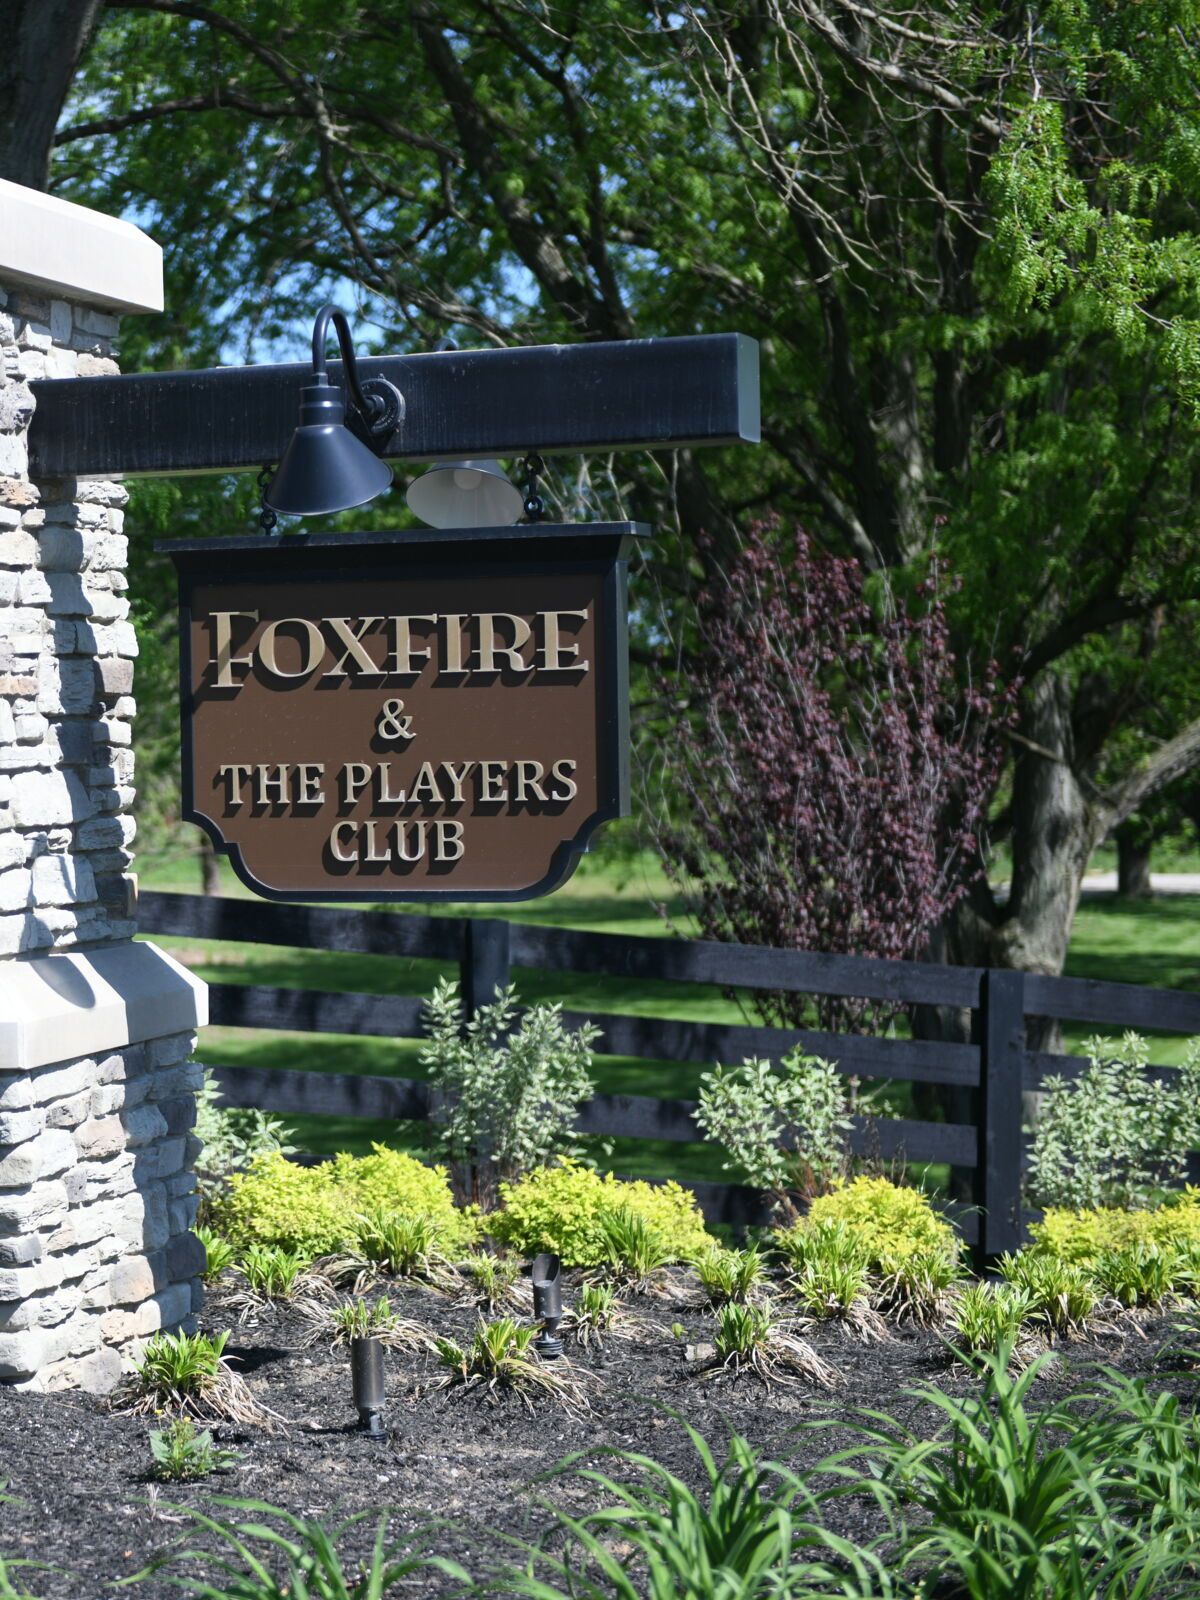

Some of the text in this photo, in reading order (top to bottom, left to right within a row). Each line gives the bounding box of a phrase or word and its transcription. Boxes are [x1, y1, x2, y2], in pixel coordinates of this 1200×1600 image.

[208, 608, 590, 688] FOXFIRE
[377, 698, 417, 740] &
[220, 759, 578, 804] THE PLAYERS
[330, 820, 465, 862] CLUB
